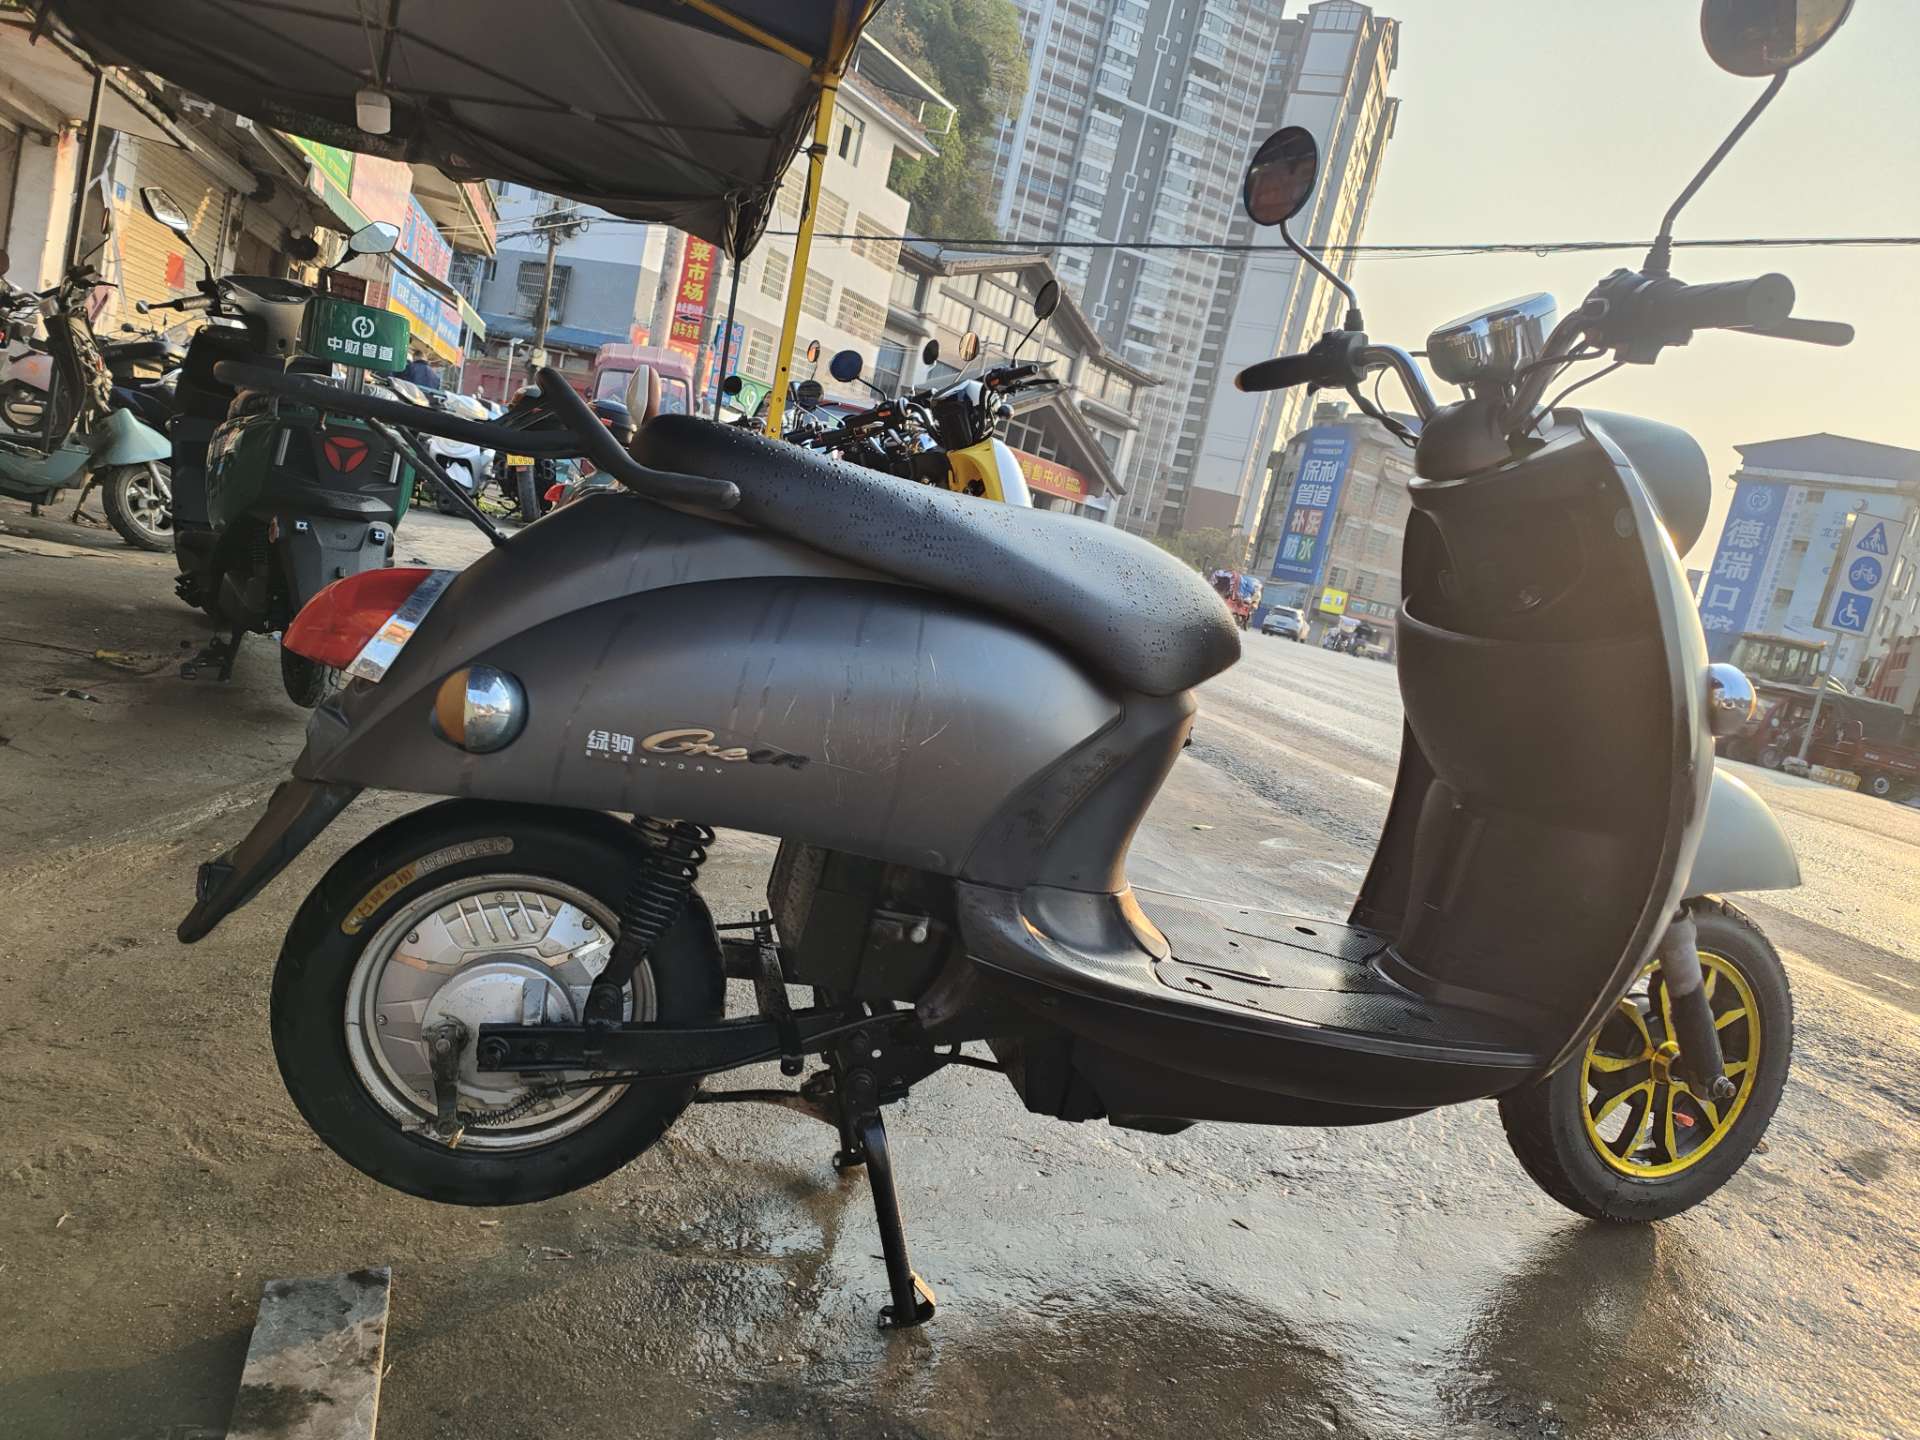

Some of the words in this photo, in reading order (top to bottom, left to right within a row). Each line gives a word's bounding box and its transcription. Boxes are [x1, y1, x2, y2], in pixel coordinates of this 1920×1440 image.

[683, 242, 711, 302] 菜市场
[327, 336, 393, 361] 中财管道
[1302, 459, 1339, 482] 保利
[1295, 483, 1332, 507] 管道
[1282, 536, 1315, 560] 防水
[587, 729, 634, 755] 绿驹
